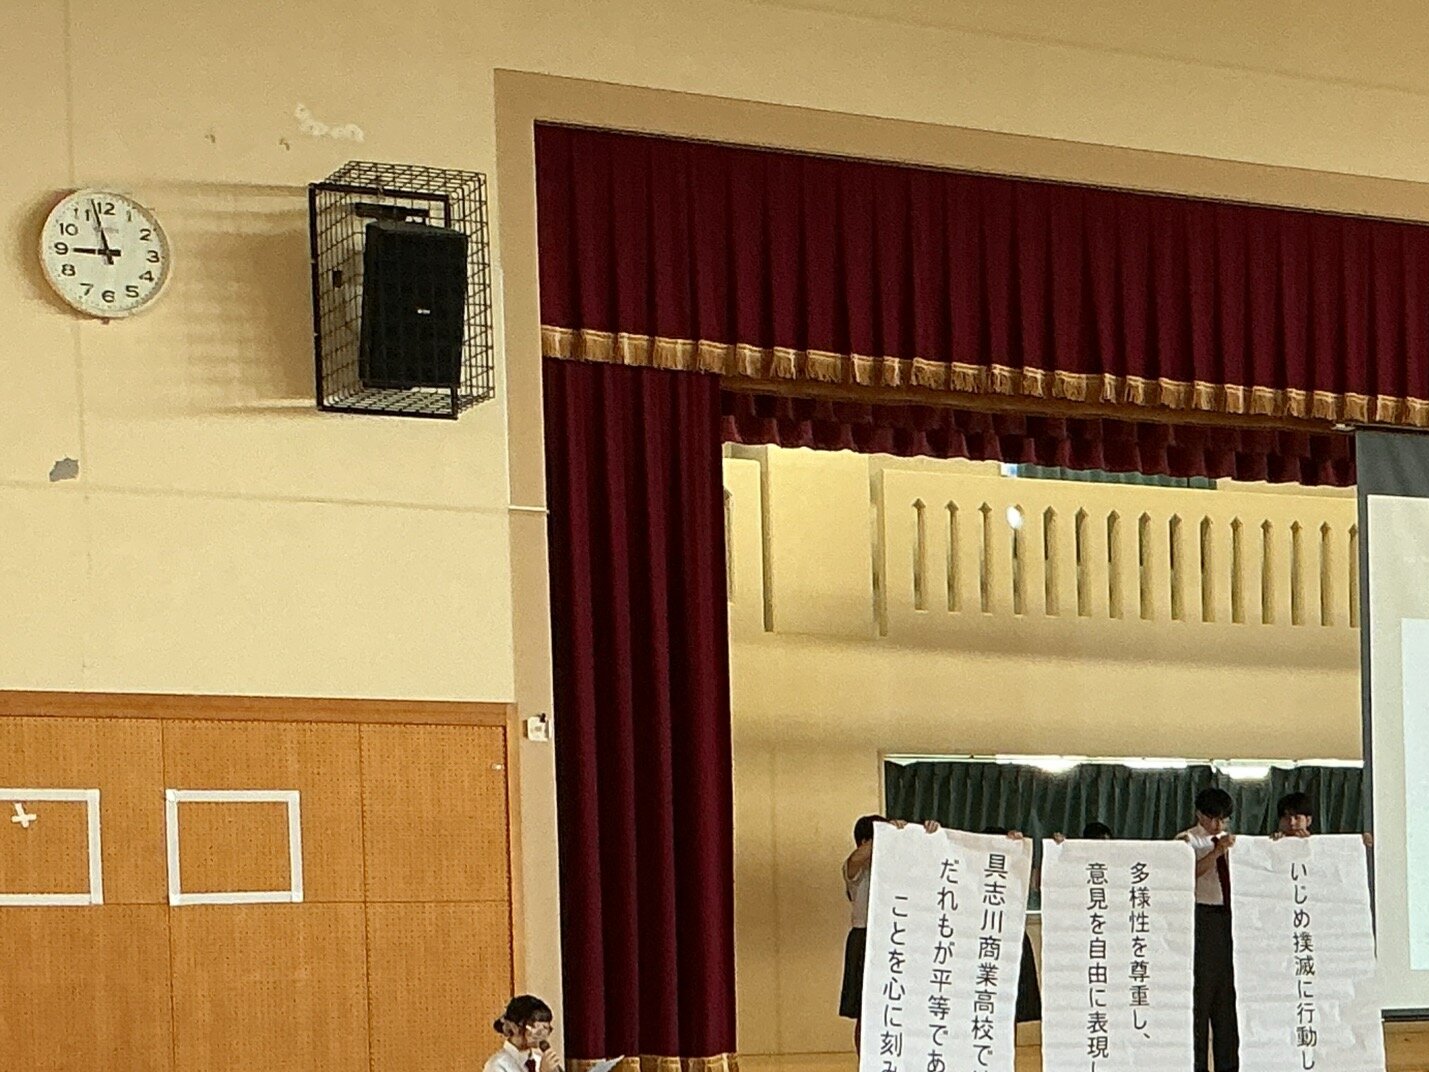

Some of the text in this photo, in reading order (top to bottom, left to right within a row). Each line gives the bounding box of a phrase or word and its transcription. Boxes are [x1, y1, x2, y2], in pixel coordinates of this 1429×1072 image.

[97, 201, 115, 216] 12
[126, 210, 132, 222] 1
[60, 222, 78, 236] 10
[140, 228, 151, 241] 2
[54, 241, 68, 255] 9
[146, 250, 159, 263] 3
[62, 263, 76, 276] 8
[139, 270, 154, 282] 4
[80, 282, 93, 296] 7
[126, 285, 139, 298] 5
[102, 290, 115, 303] 6
[1128, 862, 1150, 1038] 多様性を尊重し、
